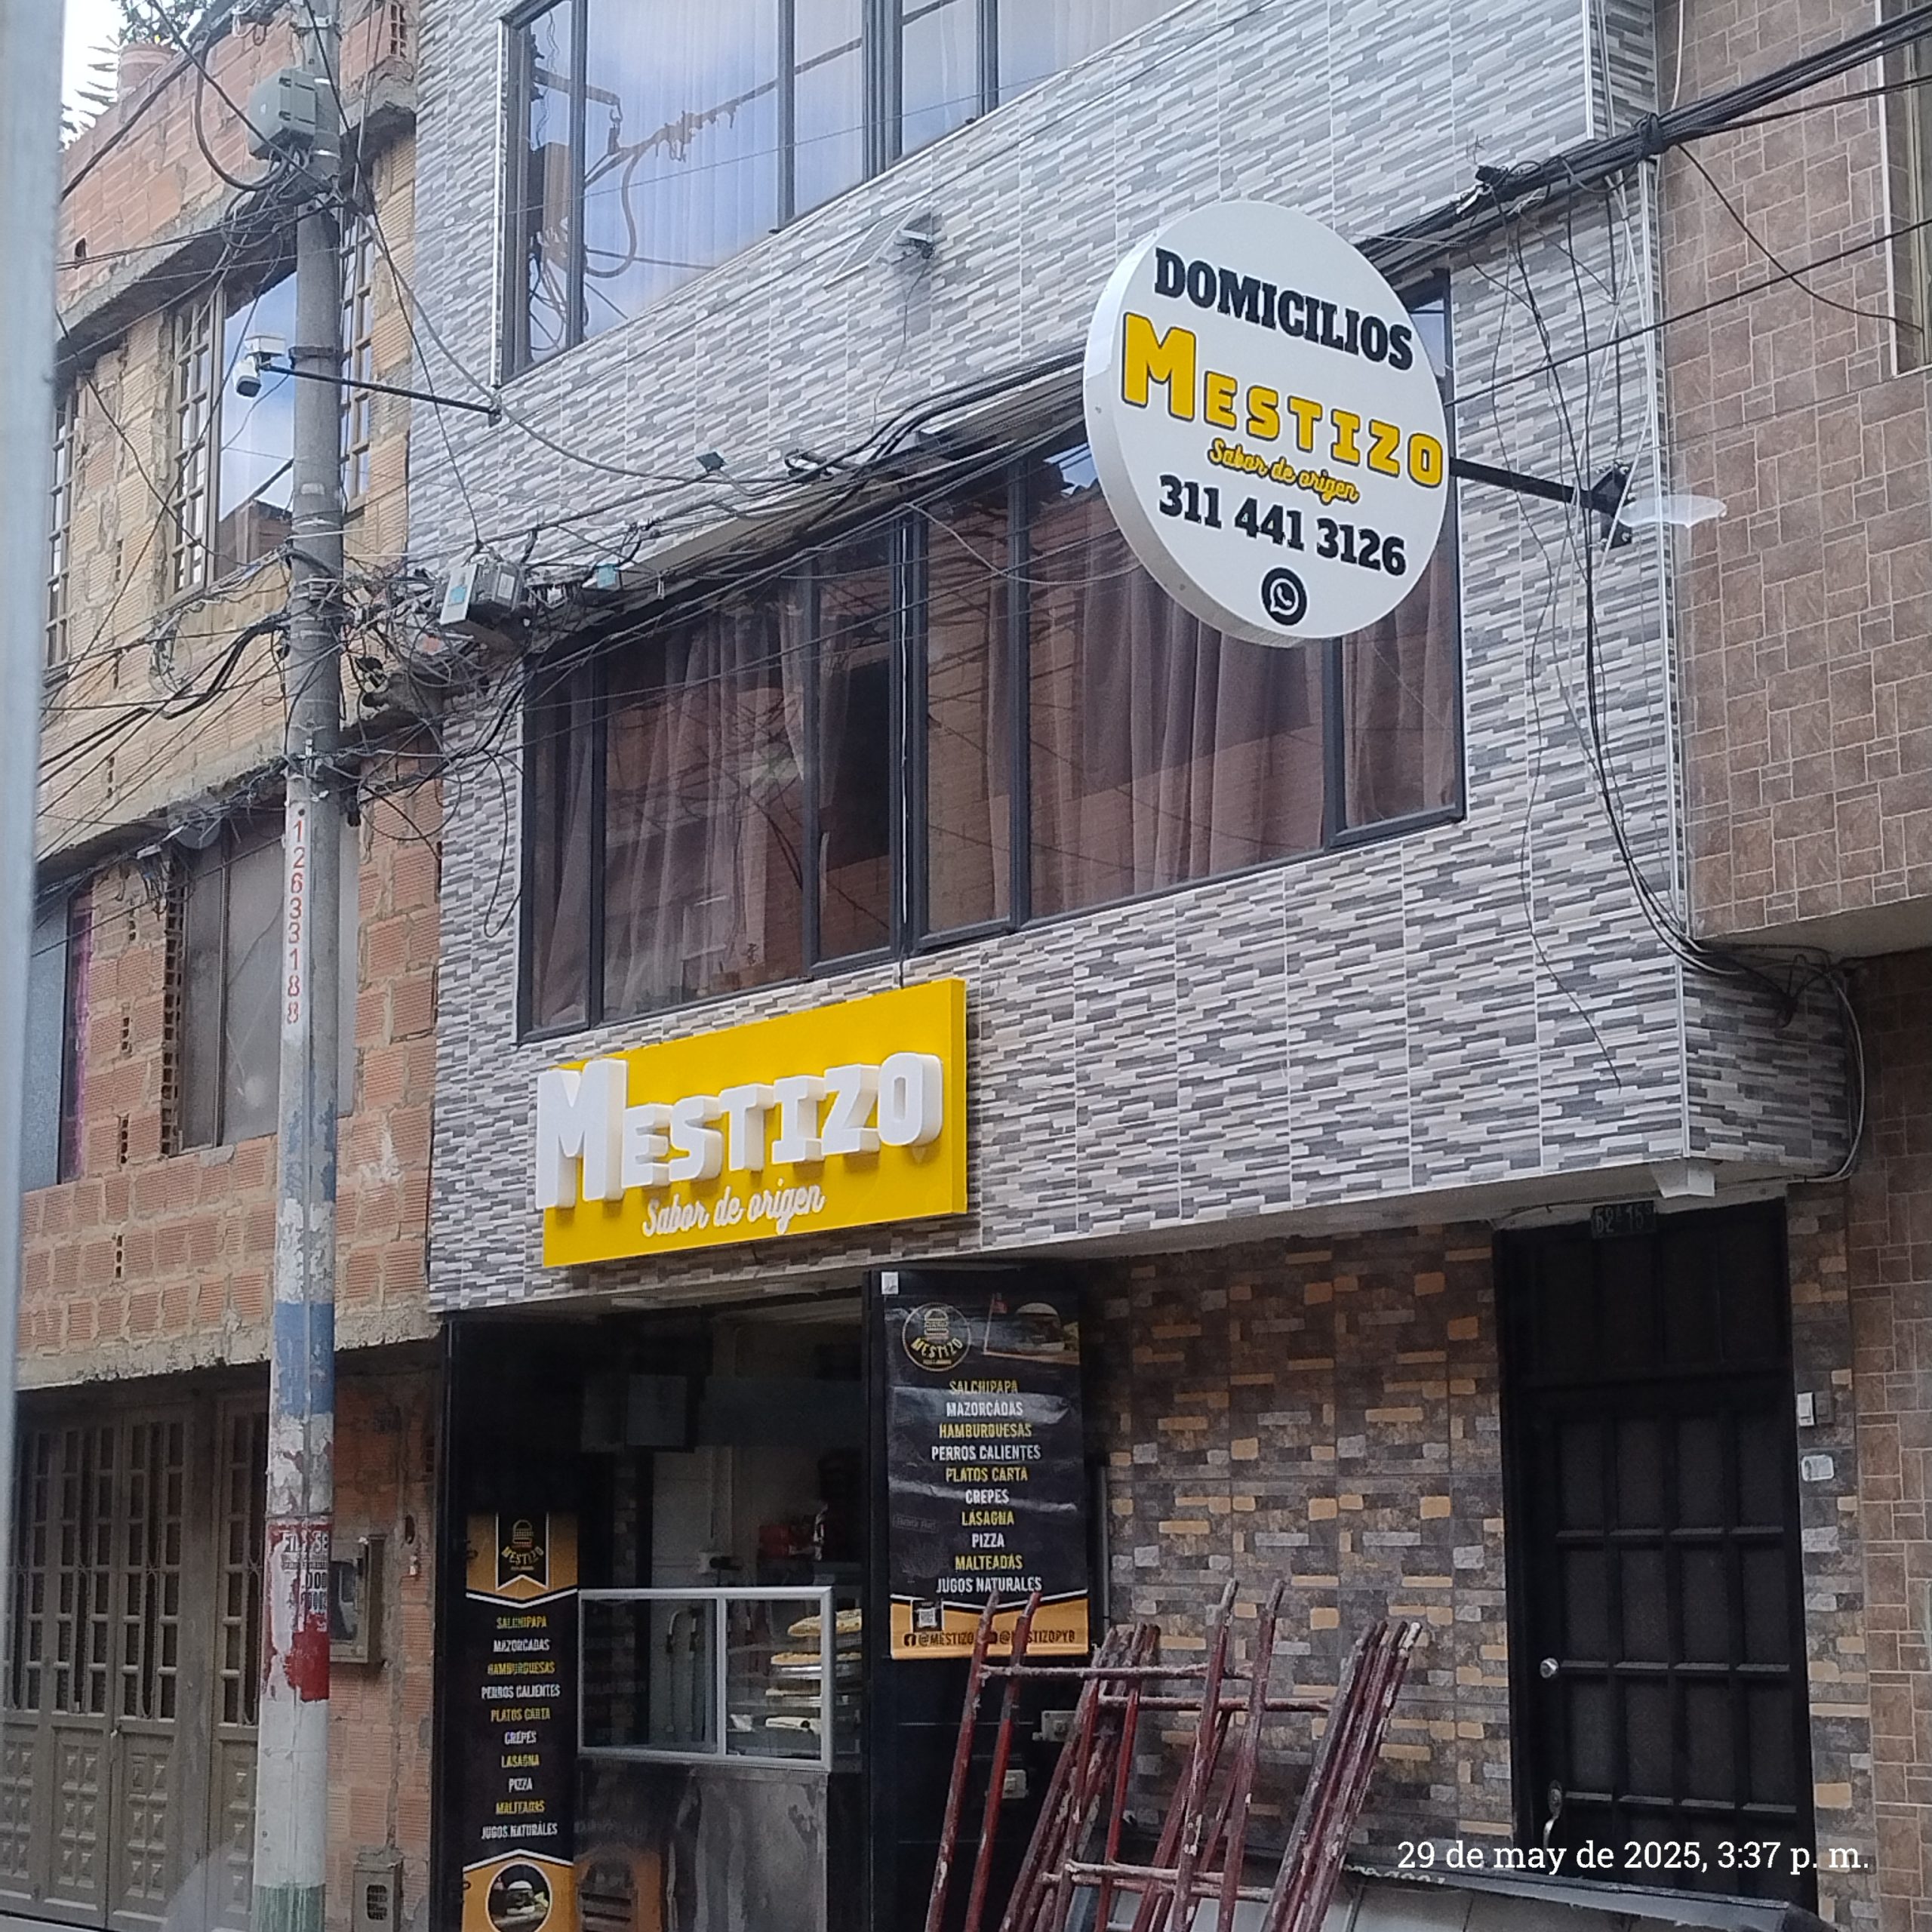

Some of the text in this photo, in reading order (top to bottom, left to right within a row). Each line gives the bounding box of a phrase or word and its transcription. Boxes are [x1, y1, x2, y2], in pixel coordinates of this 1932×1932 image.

[1154, 247, 1414, 371] DOMICILIOS
[1121, 312, 1444, 489] MESTIZO
[1208, 438, 1360, 506] Sabor de origen
[1158, 475, 1407, 576] 311 441 3126
[535, 1051, 943, 1209] MESTIZO
[641, 1178, 826, 1237] Sabor de origen
[910, 1337, 964, 1359] MESTIZO
[949, 1380, 1019, 1394] SALCHIPAPA
[946, 1401, 1023, 1417] MAZORCADAS
[939, 1423, 1032, 1439] HAMBURGUESAS
[931, 1444, 1041, 1461] PERROS CALIENTES
[946, 1466, 1029, 1483] PLATOS CARTA
[965, 1489, 1010, 1504] CREPES
[961, 1511, 1014, 1527] LASAGNA
[971, 1534, 1005, 1548] PIZZA
[501, 1546, 544, 1565] MESTIZO
[955, 1555, 1023, 1571] MALTEADAS
[936, 1577, 1042, 1594] JUGOS NATURALES
[496, 1616, 547, 1629] SALCHIPAPA
[493, 1638, 551, 1653] MAZORCADAS
[488, 1661, 555, 1675] HAMBURGUESAS
[481, 1684, 561, 1700] PERROS CALIENTES
[491, 1707, 551, 1722] PLATOS CARTA
[504, 1730, 537, 1746] CREPES
[501, 1754, 540, 1768] LASAGNA
[509, 1777, 533, 1793] PIZZA
[481, 1825, 508, 1839] JUGOS
